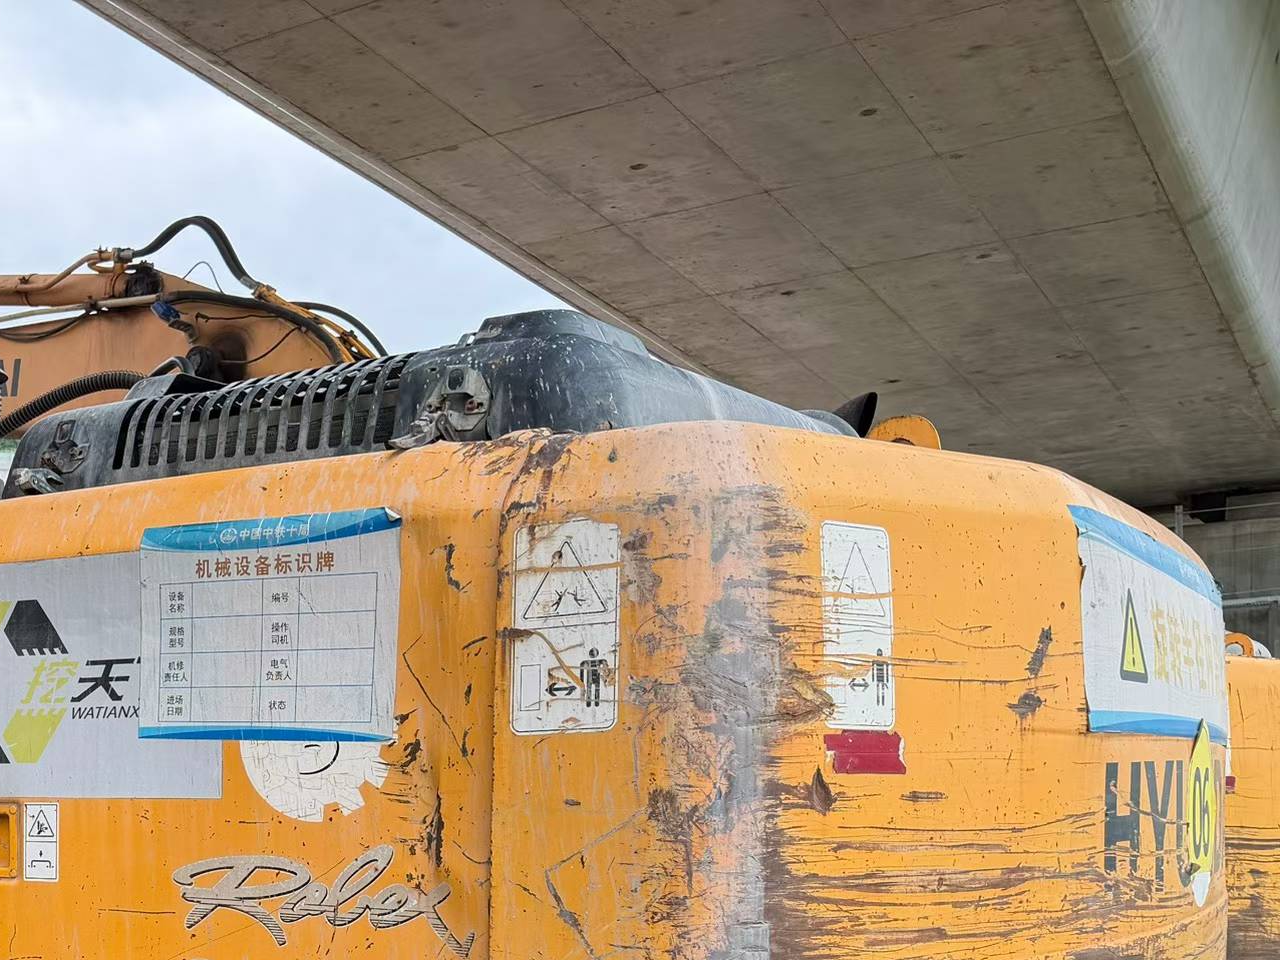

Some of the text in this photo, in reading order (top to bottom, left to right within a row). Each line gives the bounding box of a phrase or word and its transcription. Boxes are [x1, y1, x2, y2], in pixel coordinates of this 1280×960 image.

[196, 552, 335, 578] 机械设备标识牌
[168, 591, 185, 602] 设备
[271, 592, 289, 603] 编号
[168, 602, 185, 613] 名称
[169, 626, 185, 637] 规格
[271, 622, 289, 634] 操作
[168, 637, 184, 648] 型号
[271, 634, 289, 645] 司机
[168, 660, 185, 671] 机修
[270, 658, 288, 669] 电气
[20, 657, 141, 705] 挖天
[164, 671, 188, 683] 责任人
[265, 670, 292, 682] 负责人
[166, 695, 184, 705] 进场
[268, 700, 287, 711] 状态
[71, 705, 139, 720] WATIANX
[166, 706, 183, 717] 日期
[1193, 766, 1211, 860] 06
[1104, 760, 1201, 893] HYU
